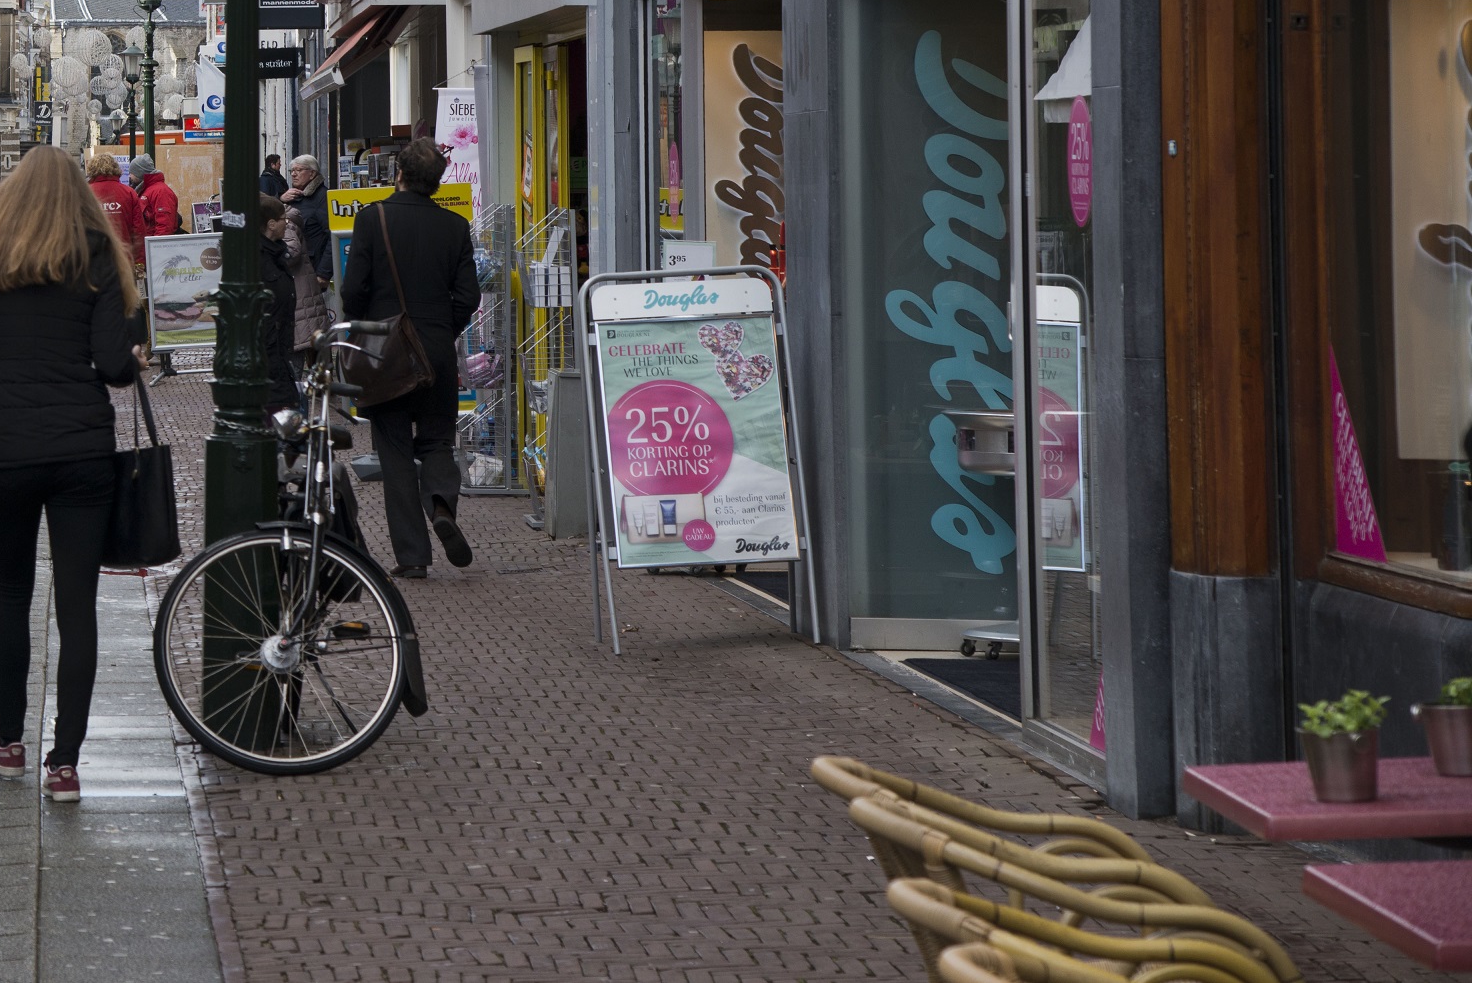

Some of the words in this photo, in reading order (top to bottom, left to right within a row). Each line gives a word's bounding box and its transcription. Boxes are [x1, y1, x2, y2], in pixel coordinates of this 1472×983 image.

[265, 60, 293, 68] sträter
[441, 162, 478, 185] Alles
[643, 284, 719, 312] Douglas
[608, 342, 687, 358] CELEBRATE
[632, 357, 654, 367] THE
[657, 354, 699, 366] THINGS
[623, 368, 642, 378] WE
[645, 366, 673, 377] LOVE
[625, 404, 710, 444] 25%
[628, 445, 689, 460] KORTING
[692, 444, 712, 458] OP
[713, 495, 724, 504] bij
[725, 493, 763, 504] besteding
[765, 492, 786, 502] vanaf
[714, 507, 721, 515] €
[757, 504, 786, 513] Clarins
[685, 533, 713, 541] CADEAU
[735, 535, 790, 556] Douglas
